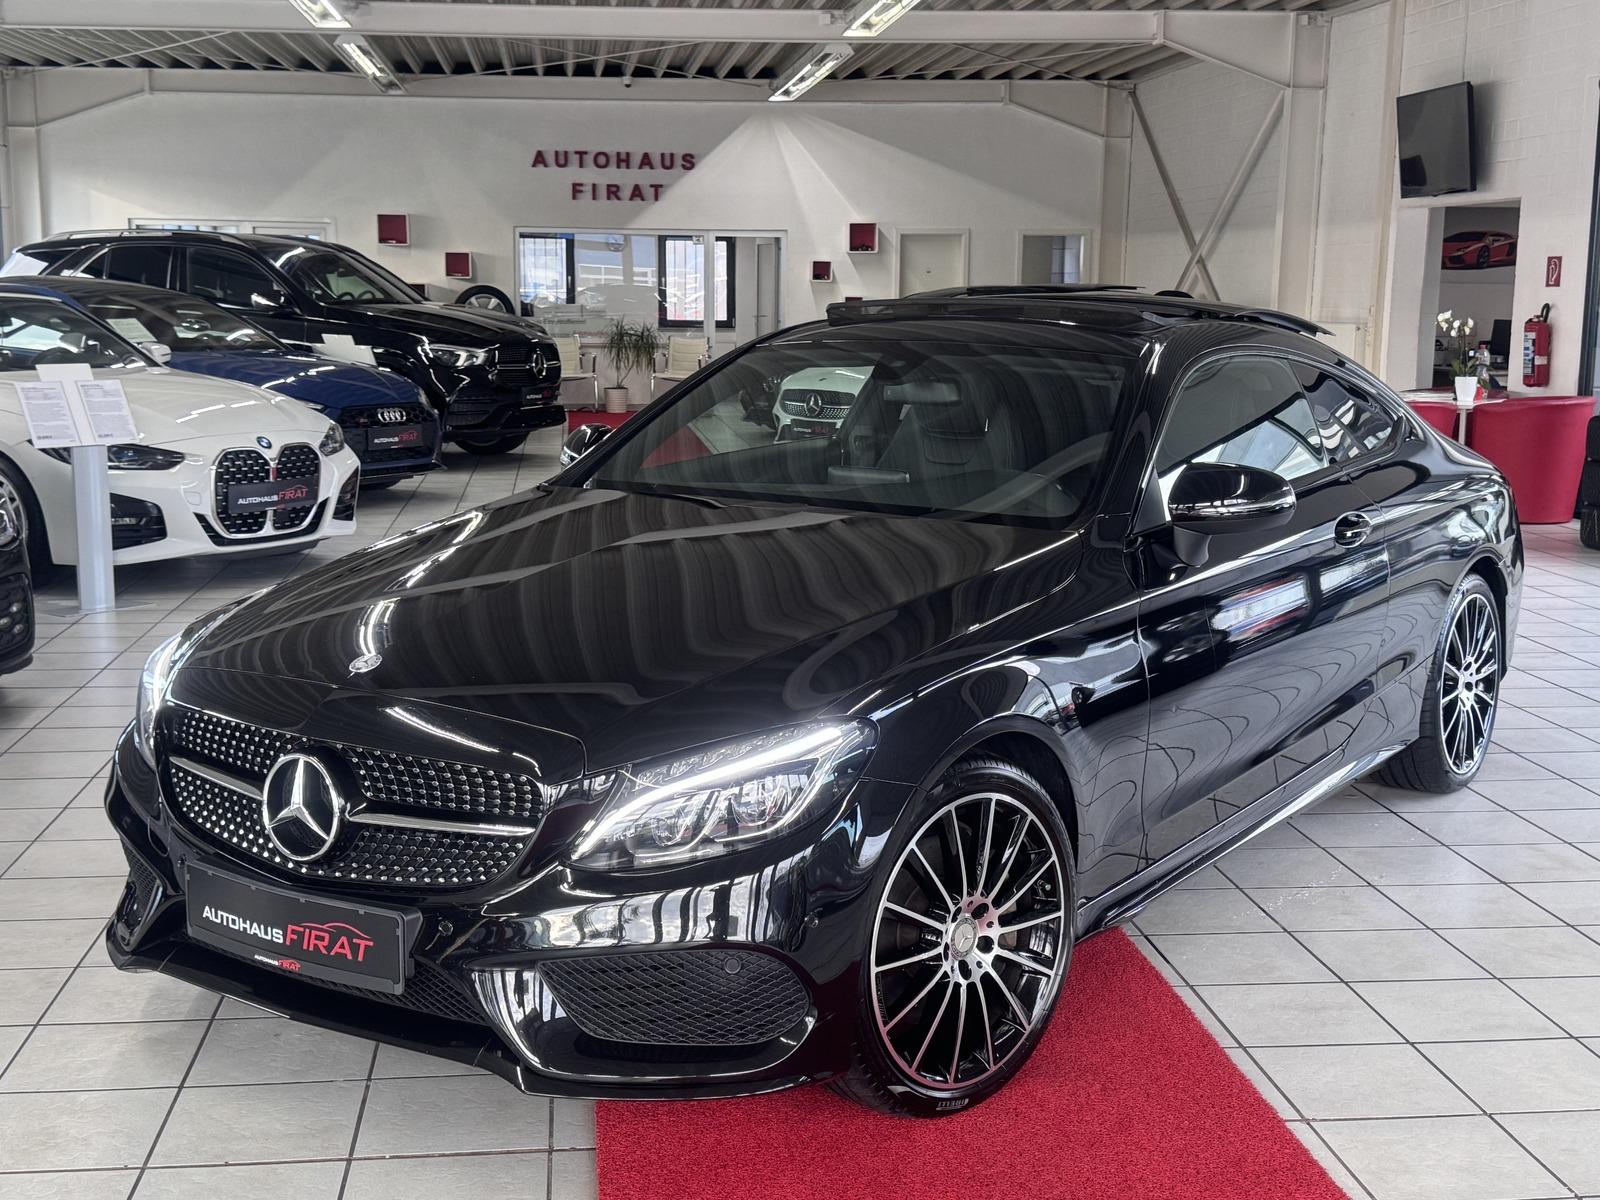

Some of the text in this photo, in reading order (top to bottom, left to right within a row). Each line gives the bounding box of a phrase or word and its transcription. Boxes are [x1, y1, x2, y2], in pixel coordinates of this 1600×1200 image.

[531, 150, 696, 171] AUTOHAUS
[571, 183, 664, 201] FIRAT
[237, 488, 308, 504] AUTOHAUS FIRAT
[202, 906, 374, 962] AUTOHAUS FIRAT
[254, 954, 301, 971] AUTOHAUS FIRAT
